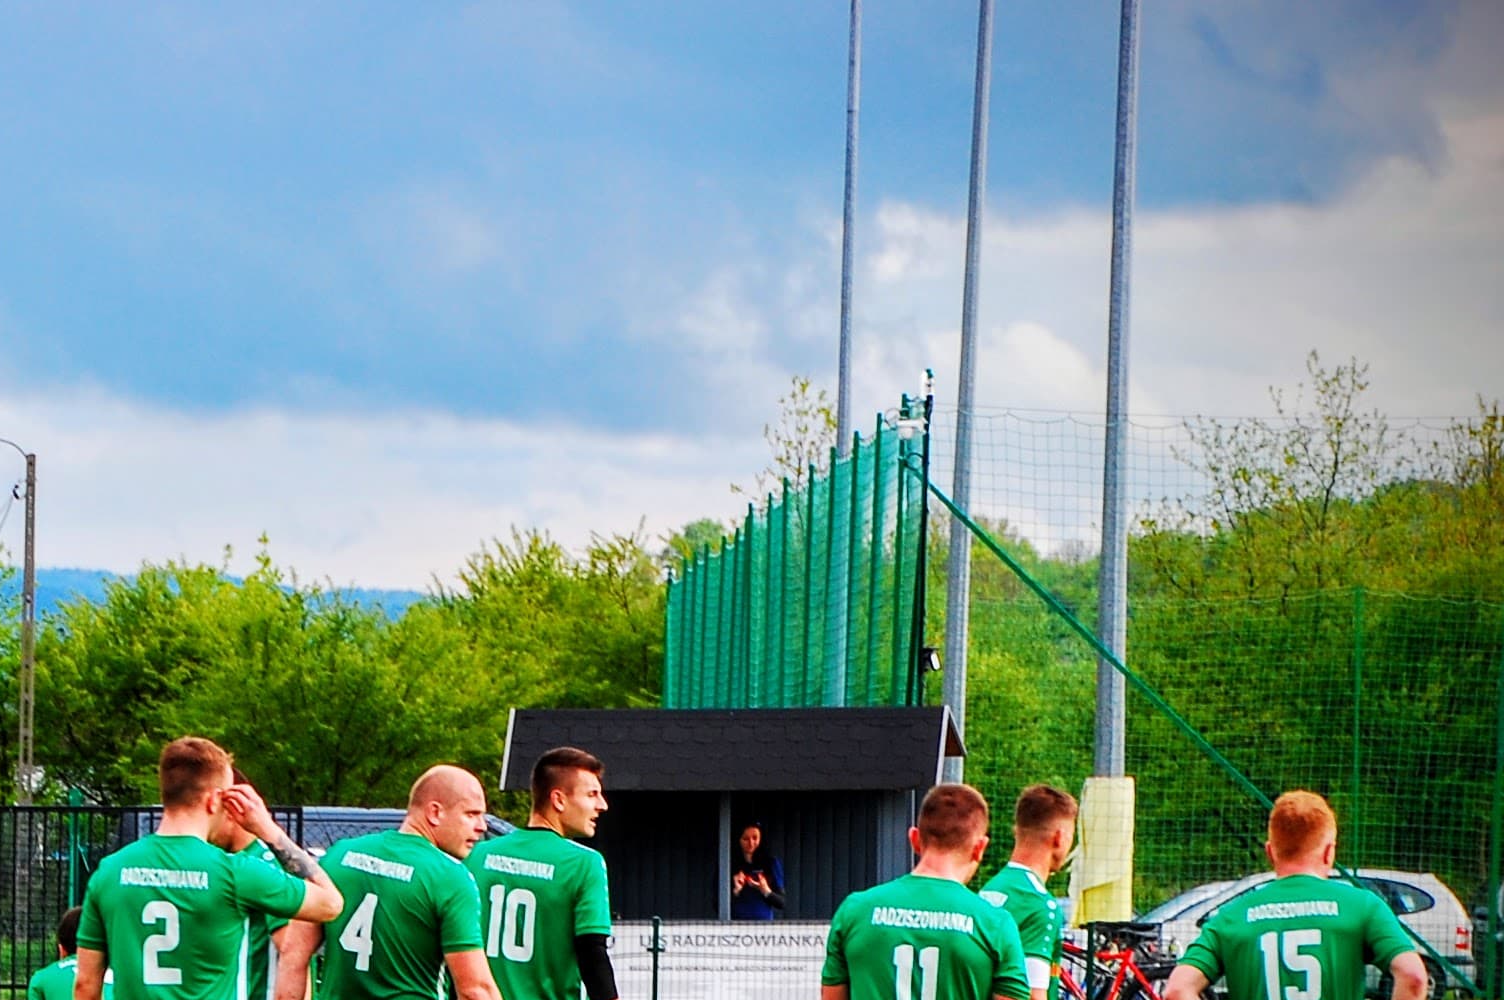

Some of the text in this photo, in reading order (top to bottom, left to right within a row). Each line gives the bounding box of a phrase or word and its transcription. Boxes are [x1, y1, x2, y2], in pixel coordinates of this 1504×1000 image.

[142, 900, 183, 985] 2
[339, 893, 378, 971] 4
[486, 884, 537, 963] 10
[672, 934, 825, 948] RADZISZOWIANKA
[872, 907, 974, 935] RADZISZOWIANKA
